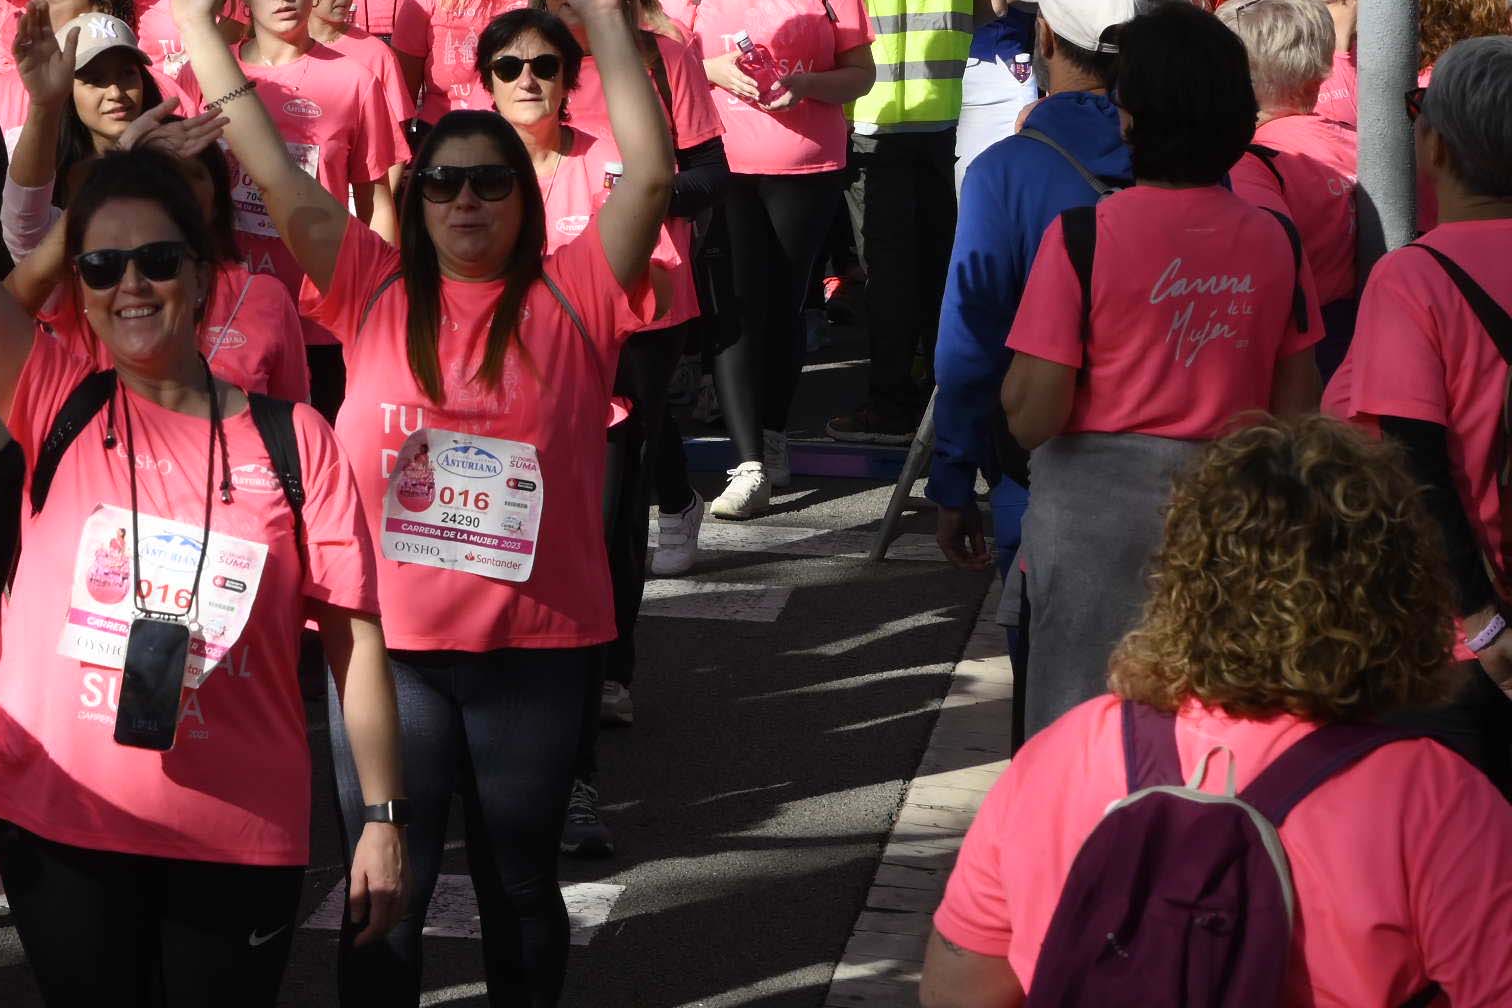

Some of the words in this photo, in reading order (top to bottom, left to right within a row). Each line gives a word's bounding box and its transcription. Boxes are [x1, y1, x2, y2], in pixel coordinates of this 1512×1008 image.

[158, 39, 185, 55] TU
[450, 83, 471, 96] TU
[1149, 257, 1256, 304] Carrera
[1165, 300, 1237, 368] Mujer
[380, 403, 423, 436] TU
[441, 454, 498, 475] ASTURIANA
[509, 460, 537, 472] SUMA
[439, 485, 491, 511] 016
[441, 511, 480, 529] 24290
[401, 523, 442, 537] CARRERA
[443, 530, 456, 539] DE
[457, 532, 469, 541] LA
[469, 534, 500, 546] MUJER
[395, 541, 441, 557] OYSHO
[476, 553, 523, 570] Santander
[136, 578, 193, 608] 016
